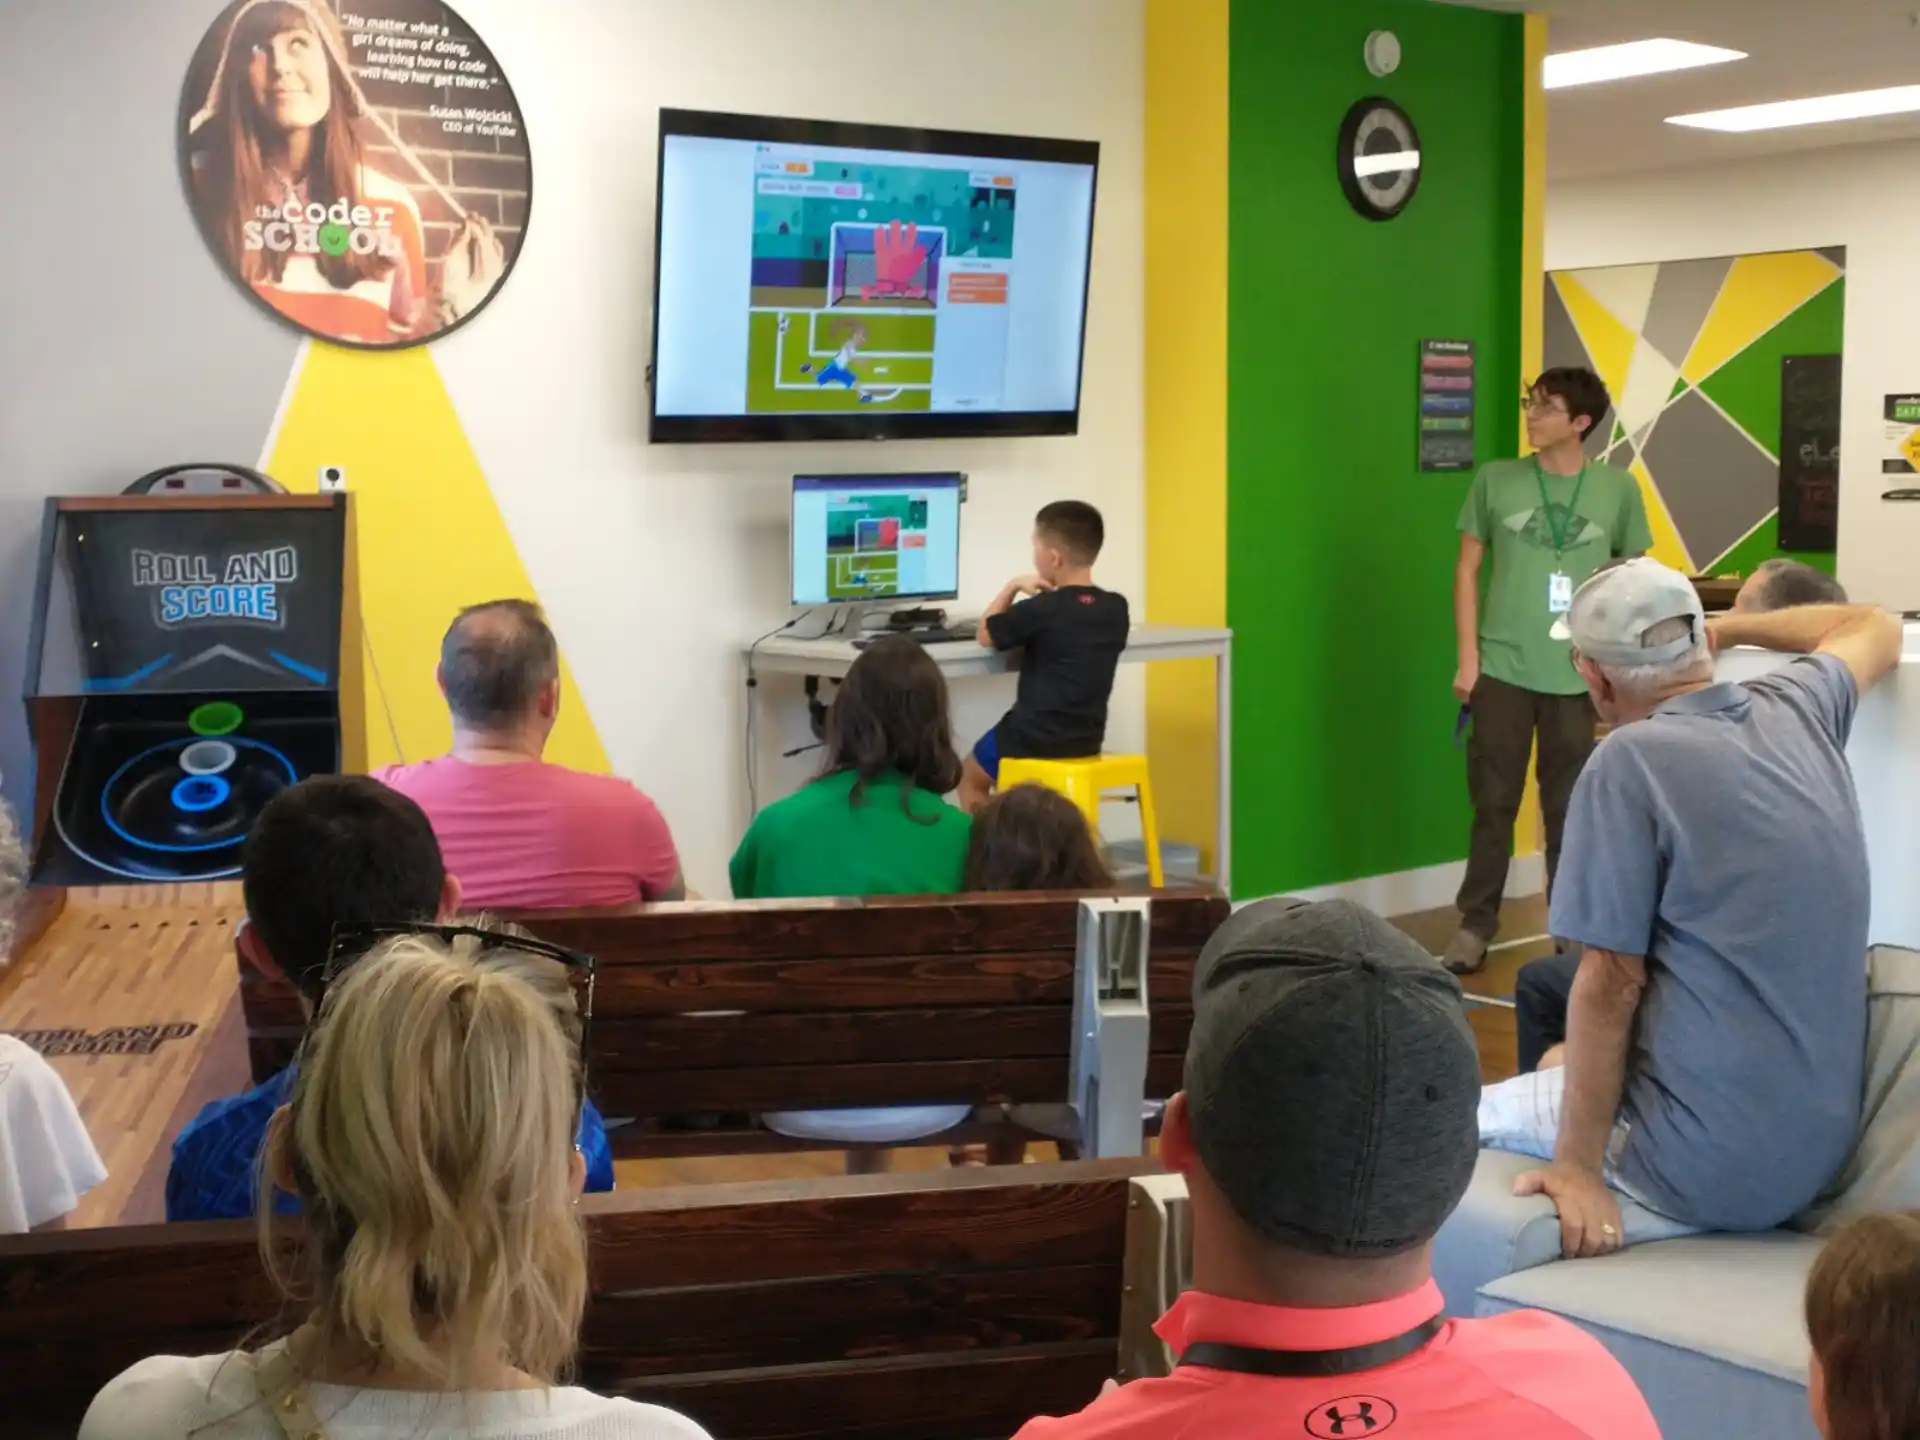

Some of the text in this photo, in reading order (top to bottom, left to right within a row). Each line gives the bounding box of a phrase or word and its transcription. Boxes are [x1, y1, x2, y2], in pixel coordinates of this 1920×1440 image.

[367, 18, 407, 31] matter
[410, 22, 439, 35] what
[441, 27, 449, 37] a
[352, 33, 471, 57] girl dreams of doing,
[367, 50, 487, 73] learning how to code
[358, 67, 380, 79] will
[383, 68, 409, 84] help
[411, 70, 431, 84] her
[434, 73, 453, 88] get
[429, 104, 462, 118] Susan
[442, 121, 516, 137] CEO of YouTube
[255, 204, 281, 219] the
[132, 545, 297, 586] ROLL AND
[161, 583, 277, 623] SCORE
